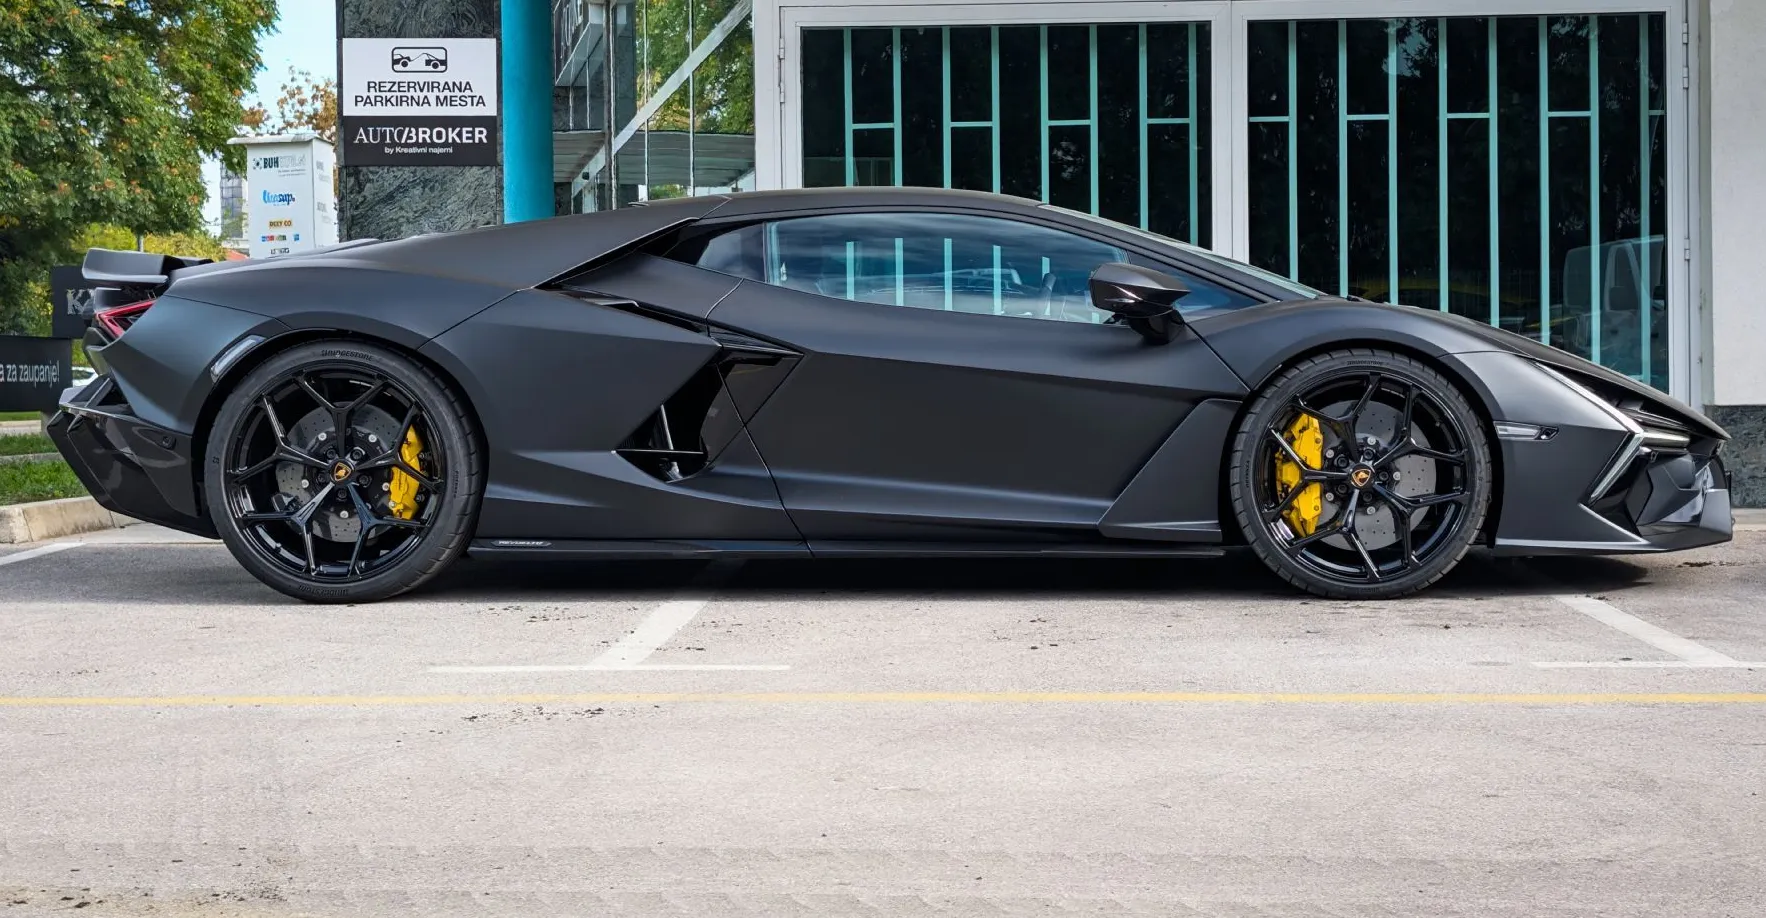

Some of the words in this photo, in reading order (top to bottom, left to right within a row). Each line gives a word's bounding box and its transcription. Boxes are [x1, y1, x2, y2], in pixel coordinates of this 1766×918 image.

[367, 81, 473, 93] REZERVIRANA
[354, 95, 431, 107] PARKIRNA
[435, 95, 486, 107] MESTA
[384, 146, 394, 155] by
[395, 146, 428, 154] Kreativni
[428, 146, 453, 155] najemi
[6, 363, 17, 382] za
[19, 360, 60, 388] zaupanje!
